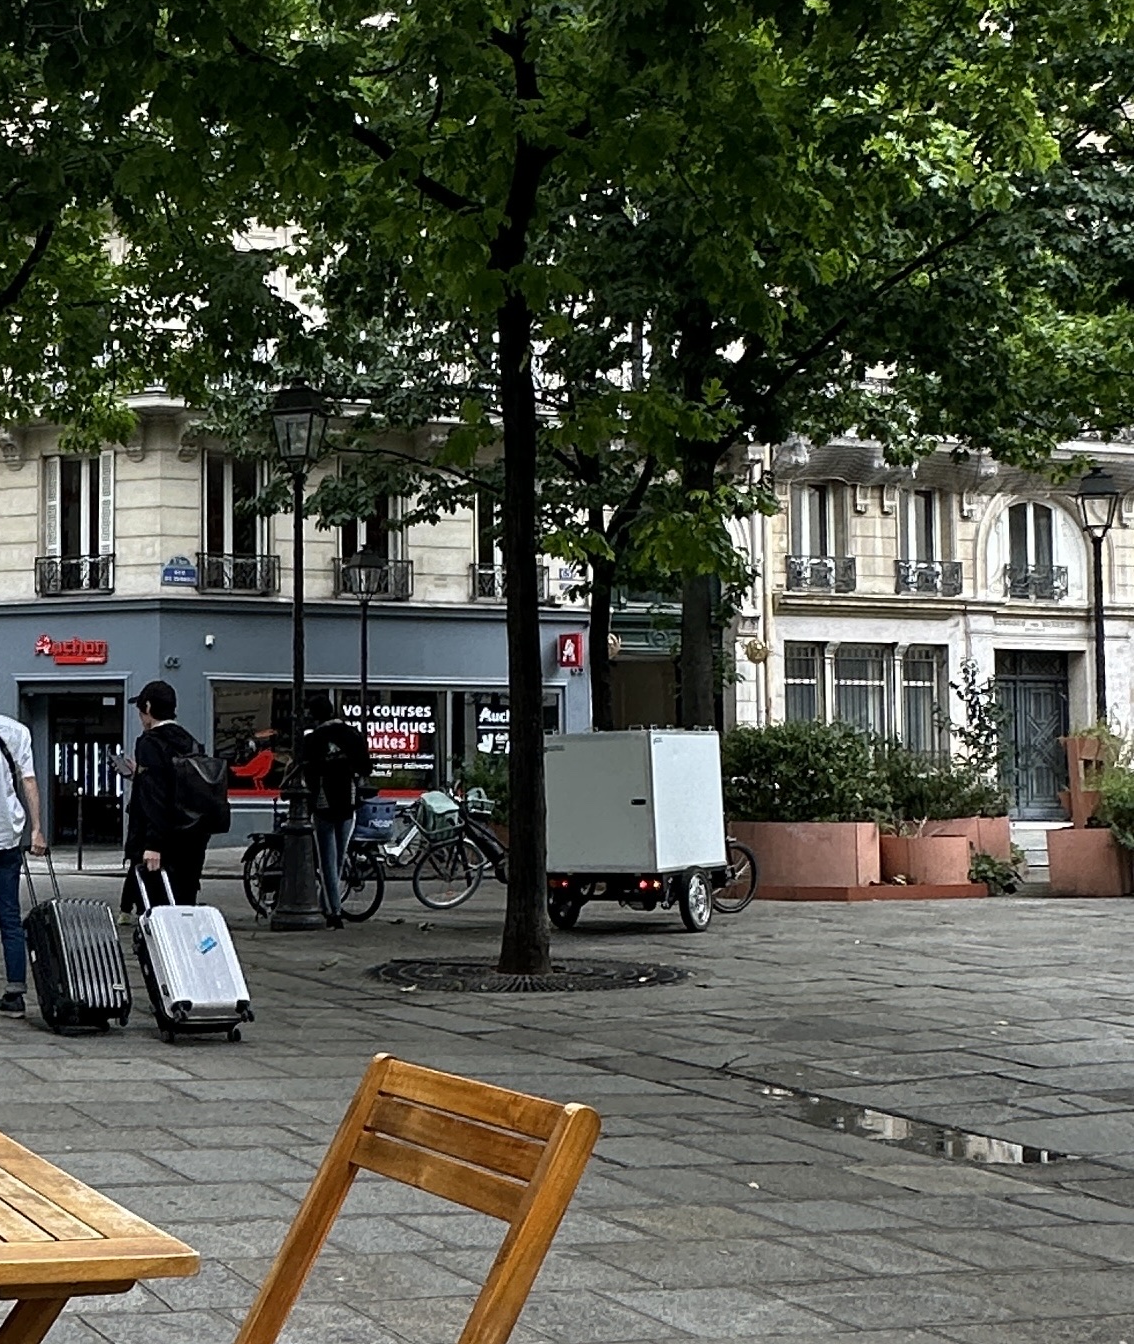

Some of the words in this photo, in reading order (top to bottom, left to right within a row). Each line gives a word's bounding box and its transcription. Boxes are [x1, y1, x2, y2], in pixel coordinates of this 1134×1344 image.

[35, 635, 107, 655] Auchan
[372, 705, 432, 717] courses
[366, 718, 436, 737] quelques
